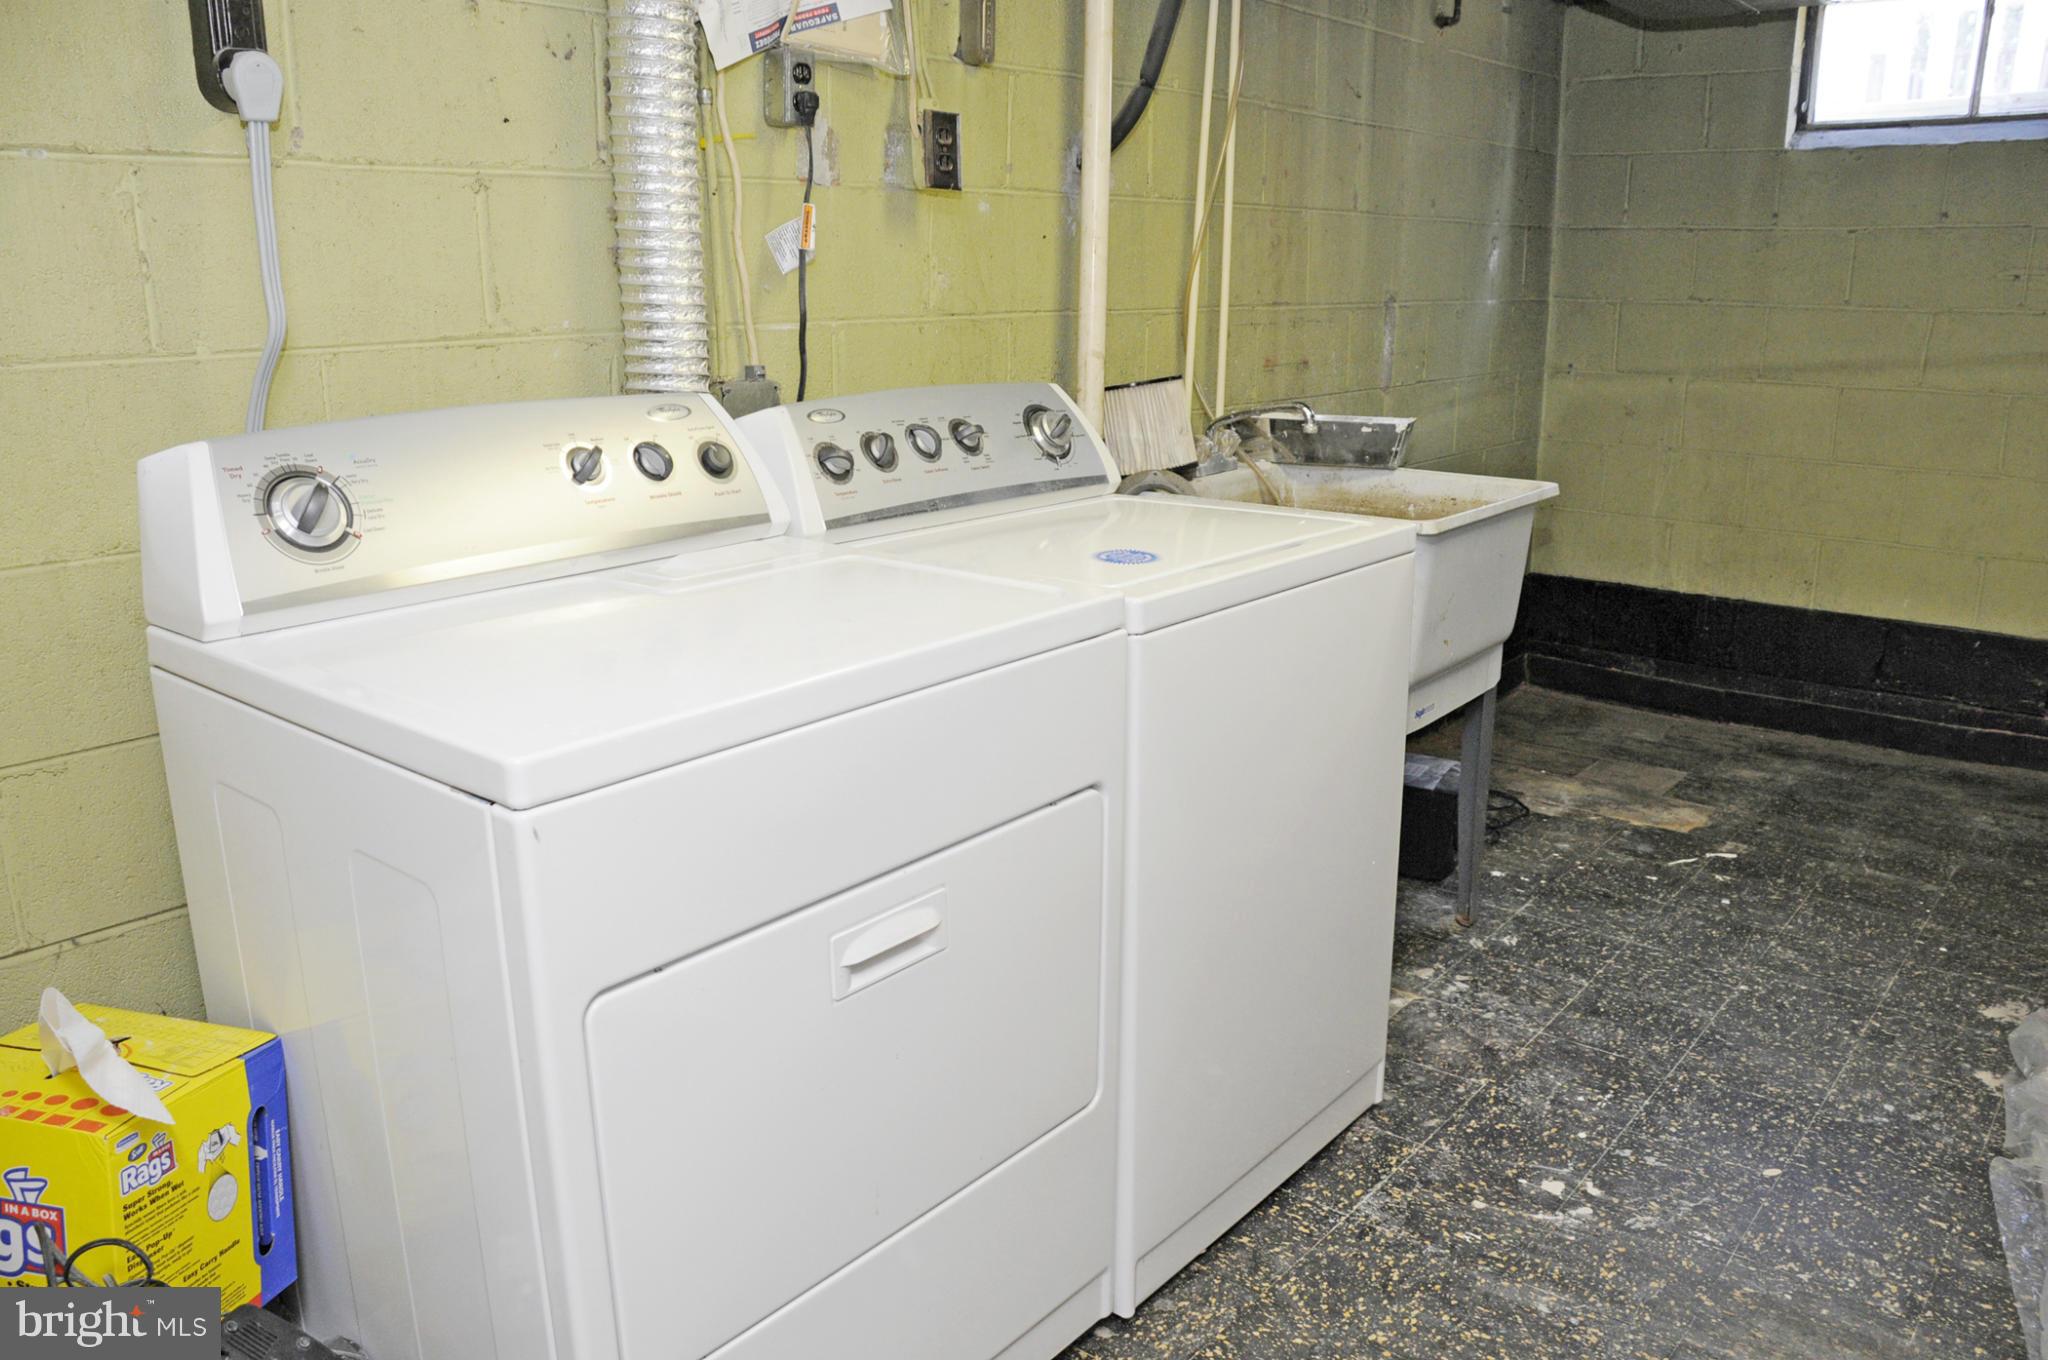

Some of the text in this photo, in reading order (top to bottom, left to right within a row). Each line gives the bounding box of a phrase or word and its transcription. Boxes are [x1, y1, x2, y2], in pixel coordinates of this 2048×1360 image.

[790, 12, 839, 32] SAFEGUAR
[120, 1151, 172, 1195] Rags
[4, 1203, 58, 1221] IN A BOX
[123, 1195, 146, 1212] Super
[123, 1204, 147, 1220] Works
[150, 1190, 170, 1205] When
[0, 1218, 52, 1273] gs
[200, 1255, 218, 1271] Carry
